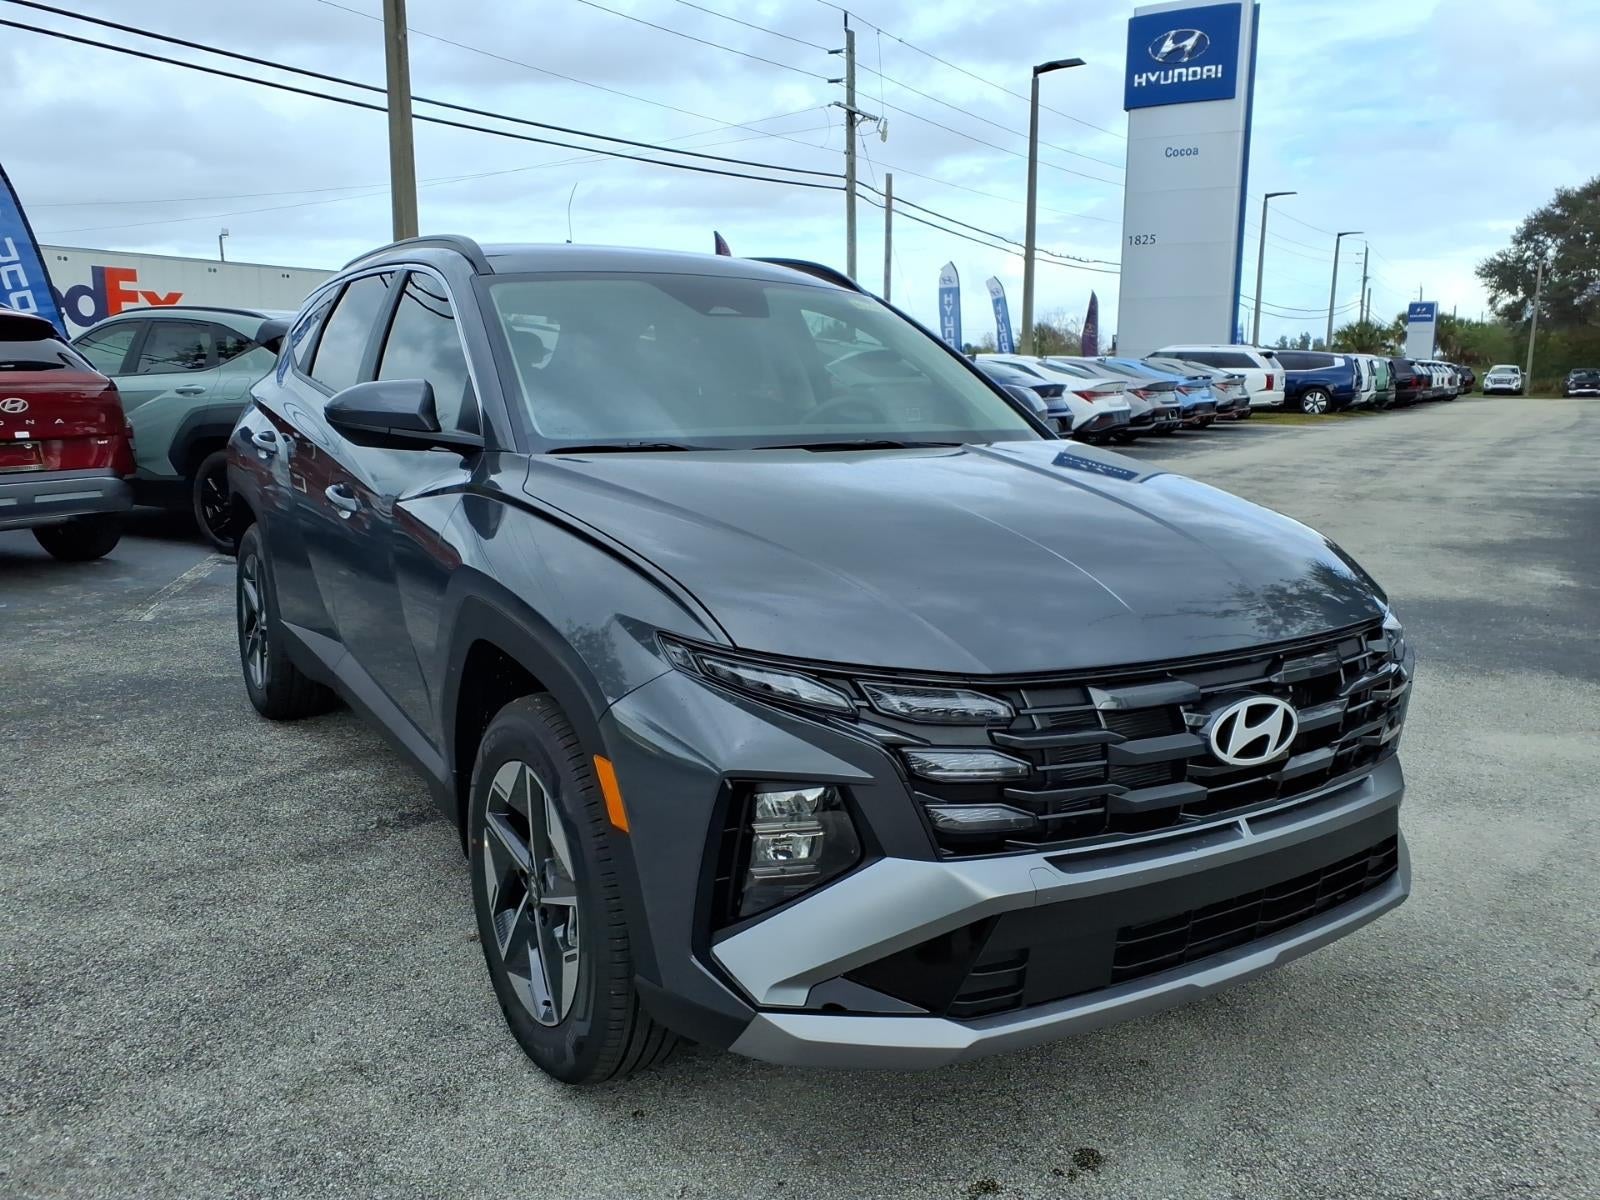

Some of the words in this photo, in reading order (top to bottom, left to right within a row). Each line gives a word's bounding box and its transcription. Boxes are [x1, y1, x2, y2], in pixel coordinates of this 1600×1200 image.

[1134, 64, 1222, 87] HYUNDAI
[1165, 147, 1199, 158] Cocoa
[1128, 234, 1156, 246] 1825
